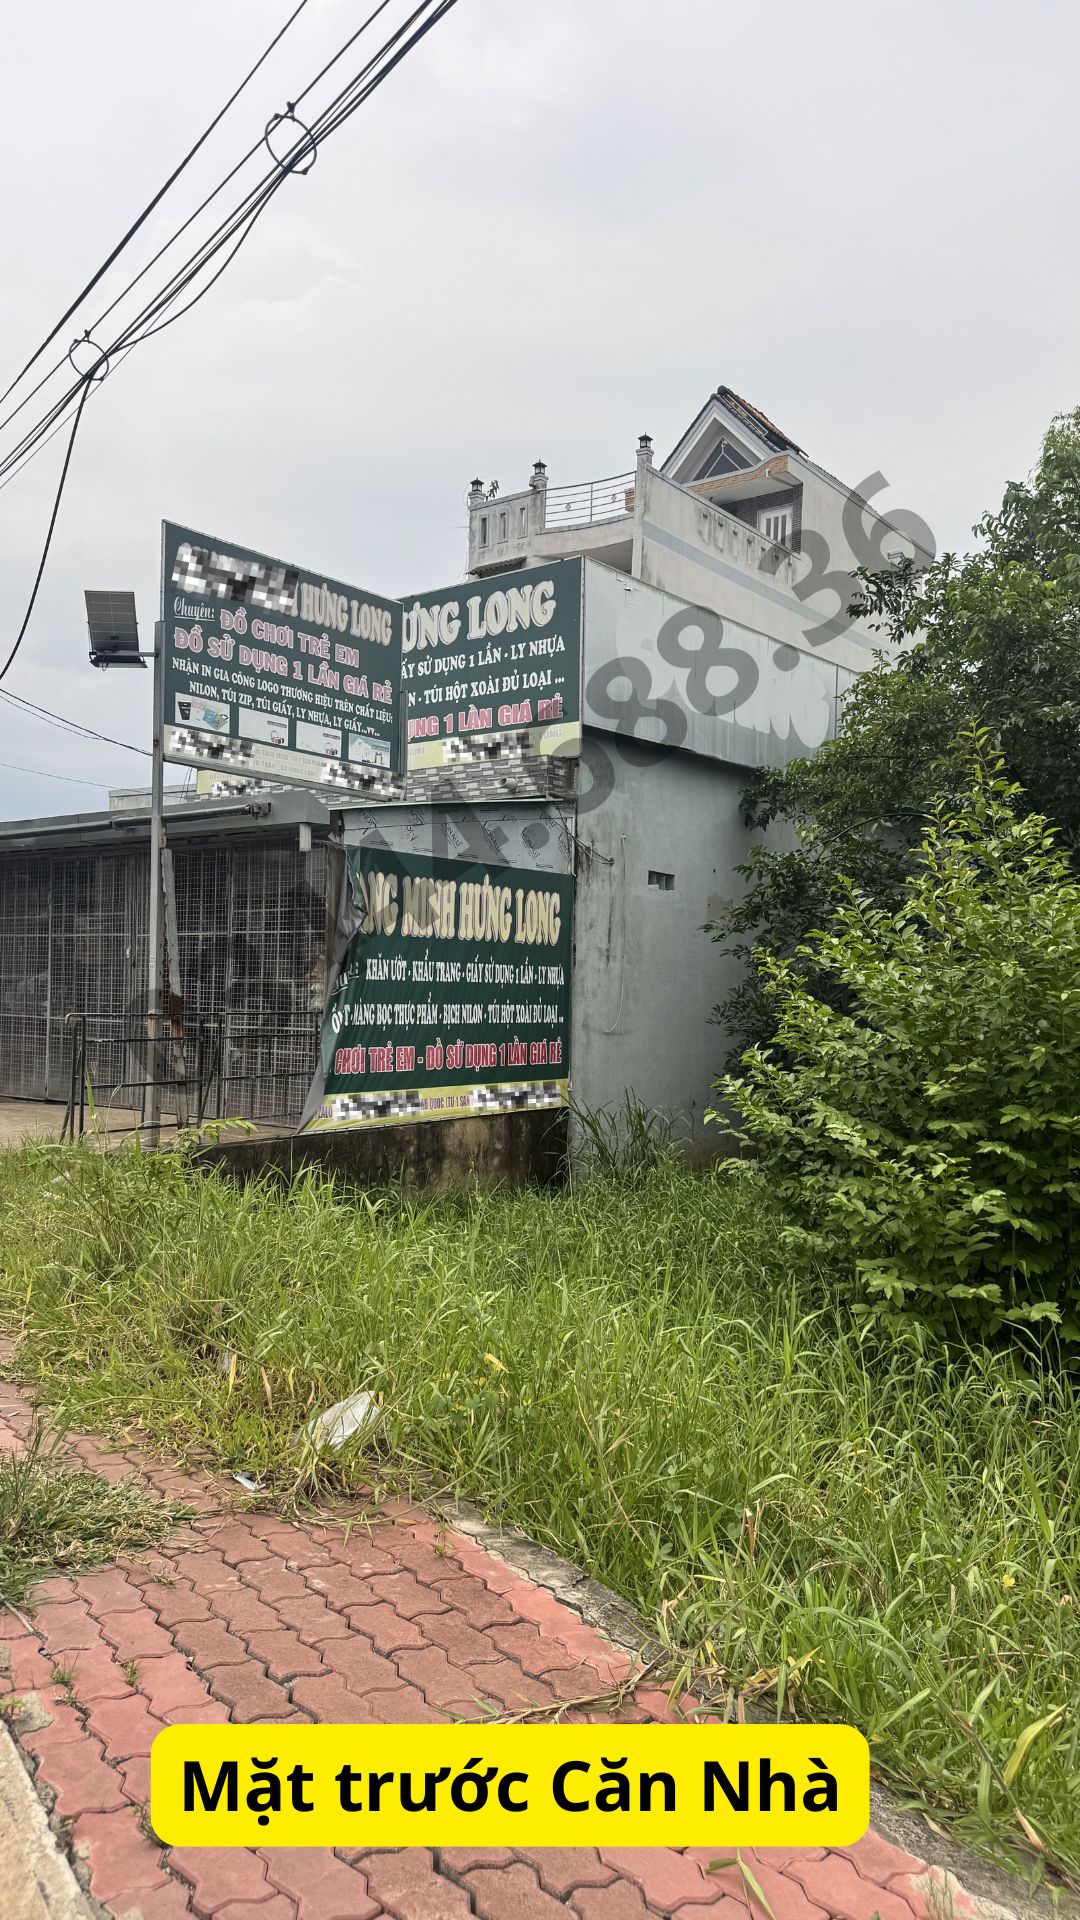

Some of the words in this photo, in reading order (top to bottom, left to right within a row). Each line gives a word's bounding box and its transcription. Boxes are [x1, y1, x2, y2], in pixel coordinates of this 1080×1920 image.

[173, 596, 216, 622] Chuyên:
[220, 606, 248, 635] ĐỒ
[251, 618, 294, 649] CHƠI
[297, 633, 331, 660] TRẺ
[334, 643, 360, 668] EM
[350, 599, 392, 647] LONG
[467, 580, 557, 640] LONG
[174, 624, 204, 653] ĐỒ
[207, 633, 236, 662] SỬ
[239, 644, 288, 677] DỤNG
[293, 660, 304, 681] 1
[307, 660, 340, 691] LẦN
[343, 674, 369, 699] GIÁ
[372, 679, 393, 705] RẺ
[417, 654, 432, 676] SỬ
[434, 653, 466, 676] DỤNG
[469, 654, 475, 668] 1
[477, 641, 502, 667] LẦN
[510, 642, 527, 660] LY
[529, 634, 566, 658] NHỰA
[172, 656, 199, 676] NHẬN
[201, 664, 212, 678] IN
[213, 667, 230, 683] GIA
[231, 671, 256, 689] CÔNG
[257, 678, 280, 694] LOGO
[280, 684, 314, 703] THƯƠNG
[314, 693, 334, 710] HIỆU
[334, 698, 354, 714] TRÊN
[355, 702, 375, 719] CHẤT
[189, 680, 220, 701] NILON,
[221, 687, 237, 703] TÚI
[256, 696, 271, 711] TÚI
[296, 706, 306, 719] LY
[333, 715, 343, 728] LY
[424, 683, 442, 704] TÚI
[445, 680, 468, 704] HỘT
[470, 675, 500, 697] XOÀI
[502, 669, 520, 692] ĐỦ
[523, 669, 552, 690] LOẠI
[443, 713, 453, 733] 1
[498, 699, 533, 727] GIÁ
[537, 692, 564, 721] RẺ
[401, 876, 457, 939] MINH
[515, 889, 562, 947] LONG
[366, 952, 390, 980] KHĂN
[391, 954, 407, 981] ƯỚT
[412, 949, 435, 981] KHẨU
[436, 961, 461, 983] TRANG
[466, 954, 484, 983] GIẤY
[485, 955, 495, 984] SỬ
[495, 964, 514, 989] DỤNG
[515, 968, 519, 984] 1
[520, 956, 534, 984] LẦN
[538, 966, 547, 985] LY
[547, 963, 565, 990] NHỰA
[377, 1003, 393, 1031] BỌC
[394, 1000, 415, 1031] THỰC
[416, 992, 438, 1025] PHẨM
[443, 1004, 460, 1030] BỊCH
[462, 1004, 484, 1024] NILON
[488, 998, 500, 1024] TÚI
[501, 999, 515, 1029] HỘT
[516, 998, 532, 1024] XOÀI
[533, 997, 543, 1024] ĐỦ
[544, 1004, 558, 1029] LOẠI
[334, 1044, 367, 1076] CHƠI
[368, 1040, 394, 1073] TRẺ
[395, 1046, 416, 1072] EM
[425, 1037, 444, 1070] ĐỒ
[446, 1038, 465, 1069] SỬ
[465, 1043, 498, 1072] DỤNG
[499, 1043, 506, 1067] 1
[508, 1035, 528, 1066] LẦN
[530, 1038, 548, 1065] GIÁ
[549, 1036, 563, 1064] RẺ
